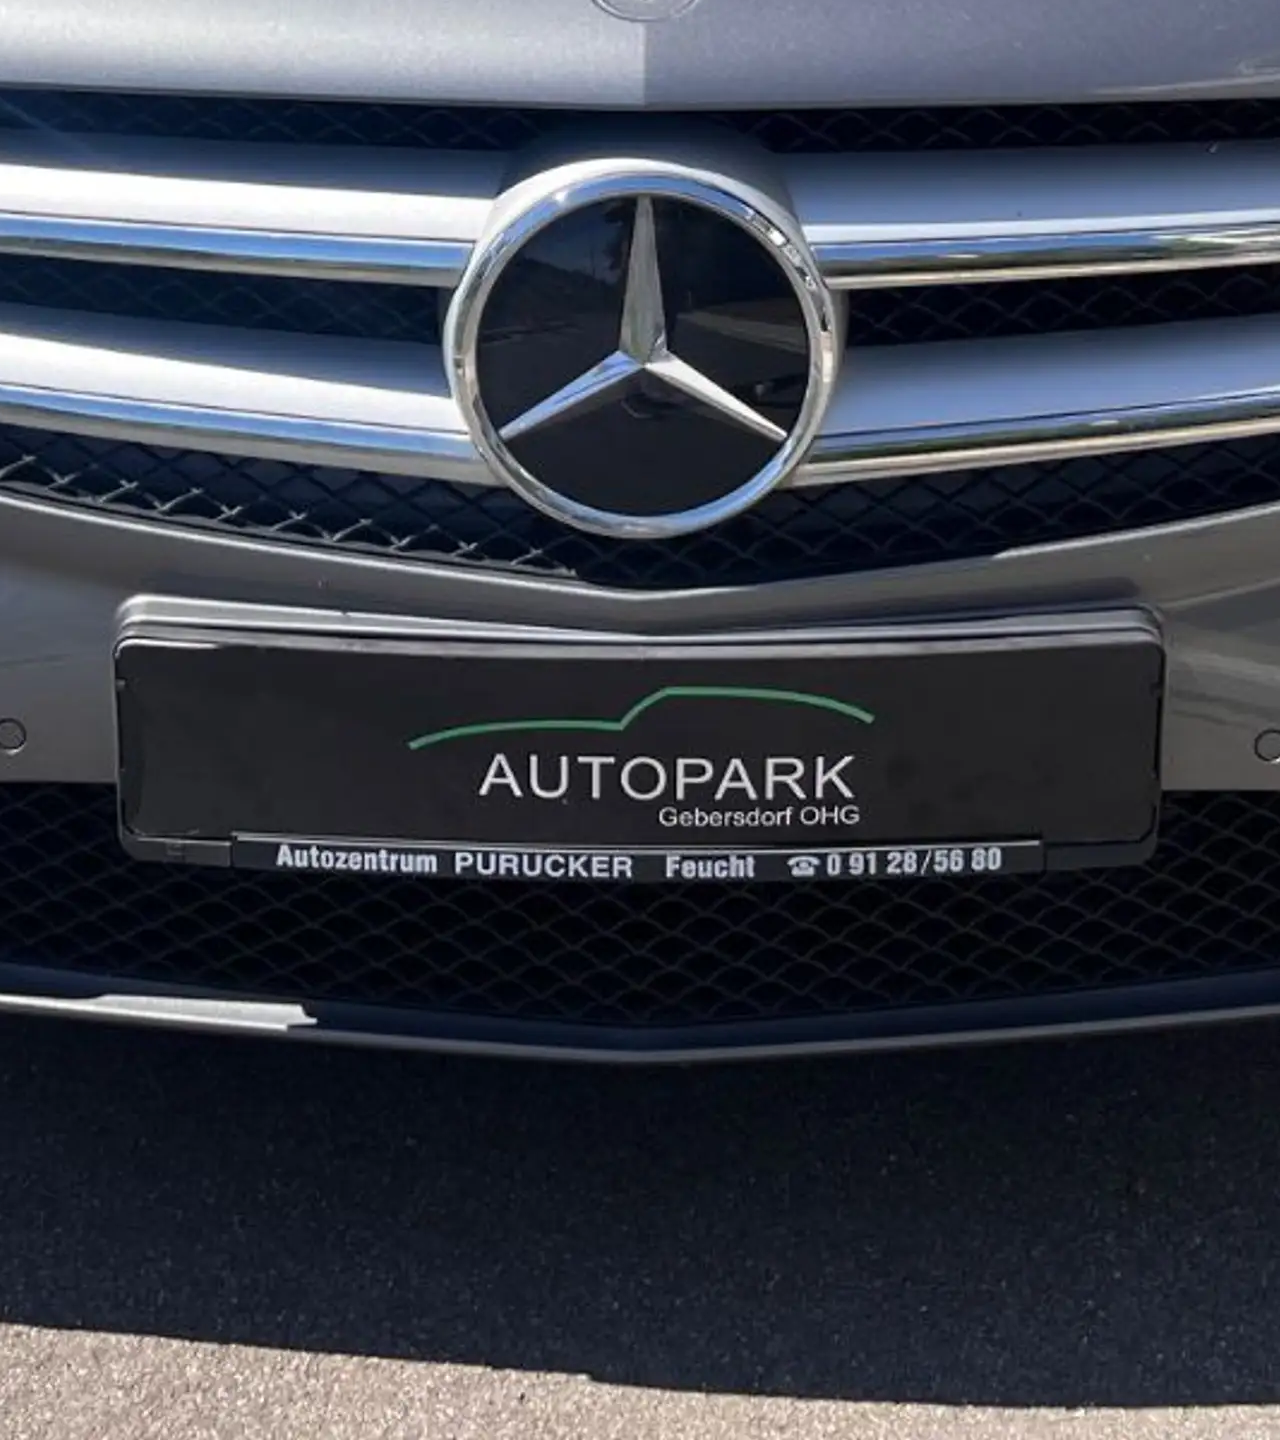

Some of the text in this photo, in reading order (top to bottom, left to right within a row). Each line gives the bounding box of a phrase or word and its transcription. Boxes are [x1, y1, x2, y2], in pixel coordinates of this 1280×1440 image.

[478, 753, 856, 801] AUTOPARK
[658, 804, 861, 828] Gebersdorf OHG
[275, 844, 438, 873] Autozentrum
[454, 851, 633, 879] PURUCKER
[665, 854, 757, 879] Feucht
[848, 852, 877, 876] 91
